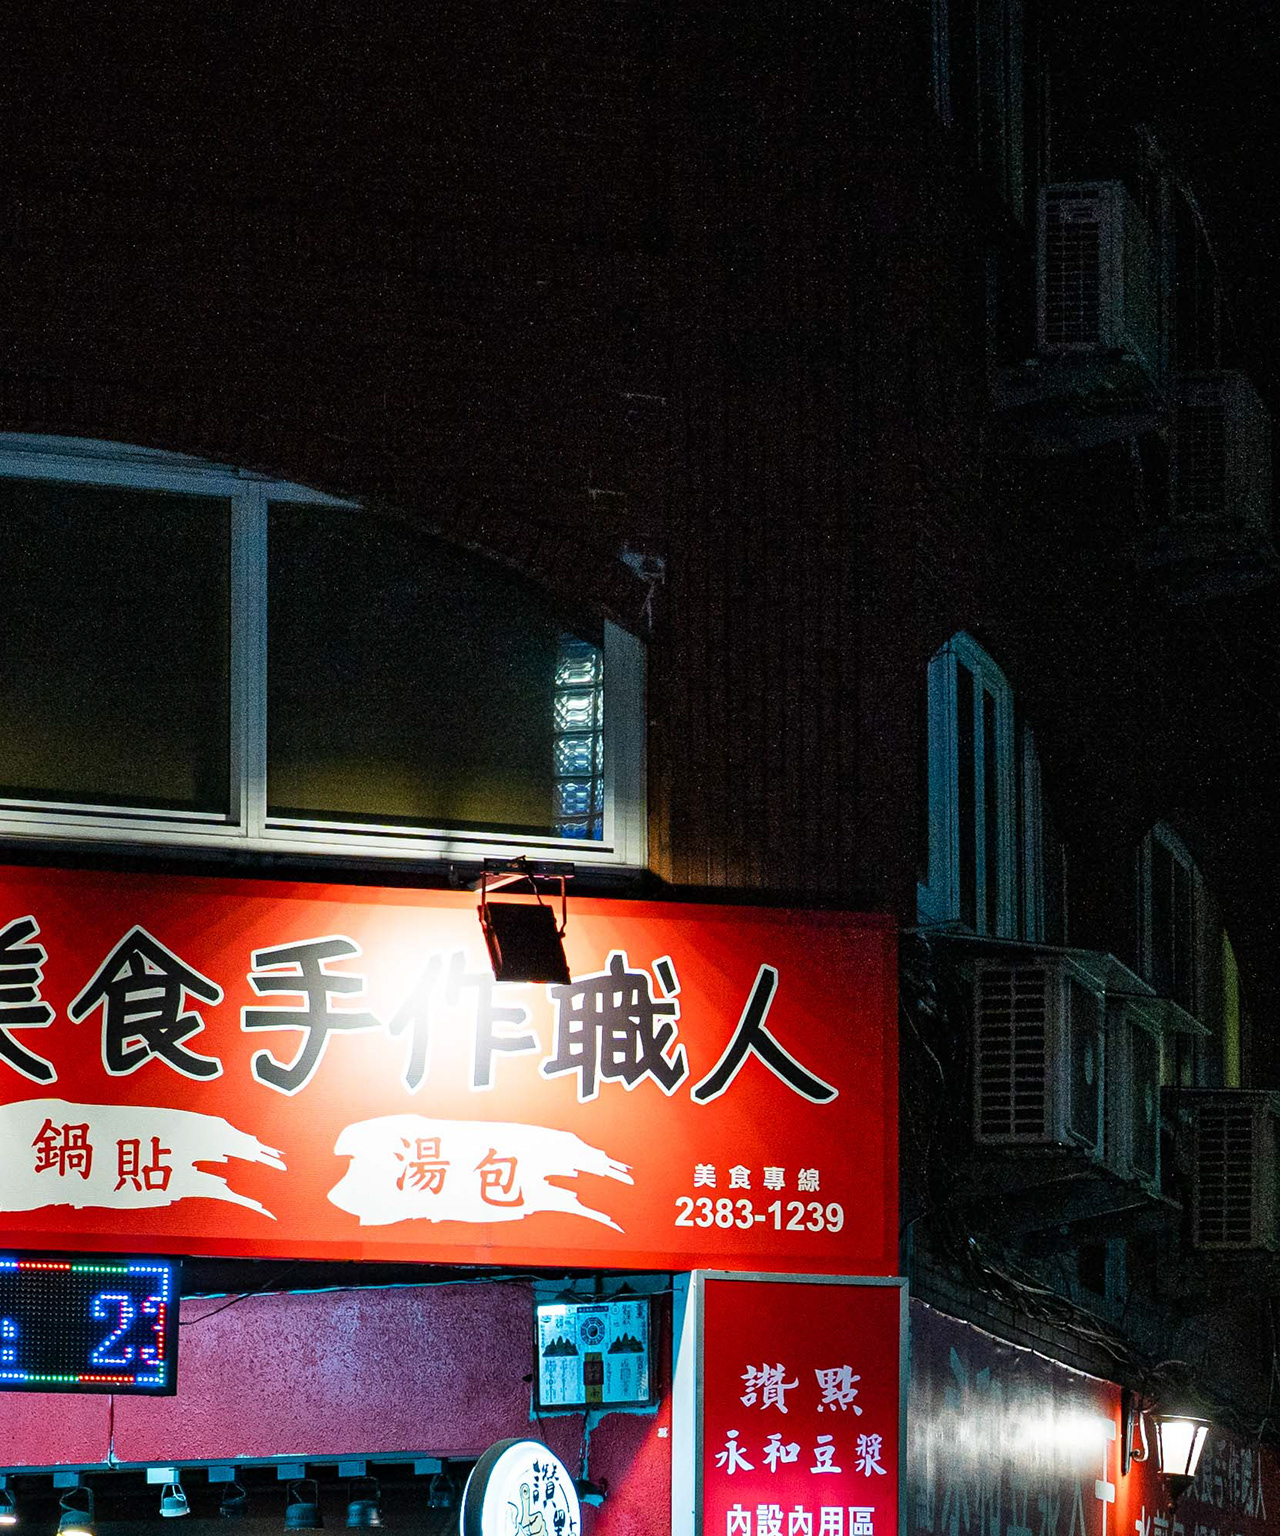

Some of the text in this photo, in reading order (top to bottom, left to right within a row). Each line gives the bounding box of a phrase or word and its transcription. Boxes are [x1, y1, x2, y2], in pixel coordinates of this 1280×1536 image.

[33, 1118, 173, 1191] 鍋貼
[395, 1136, 523, 1208] 湯包
[693, 1163, 821, 1193] 美食專線
[675, 1195, 844, 1234] 2383-1239
[740, 1363, 863, 1416] 讚點
[715, 1429, 887, 1477] 永和豆漿
